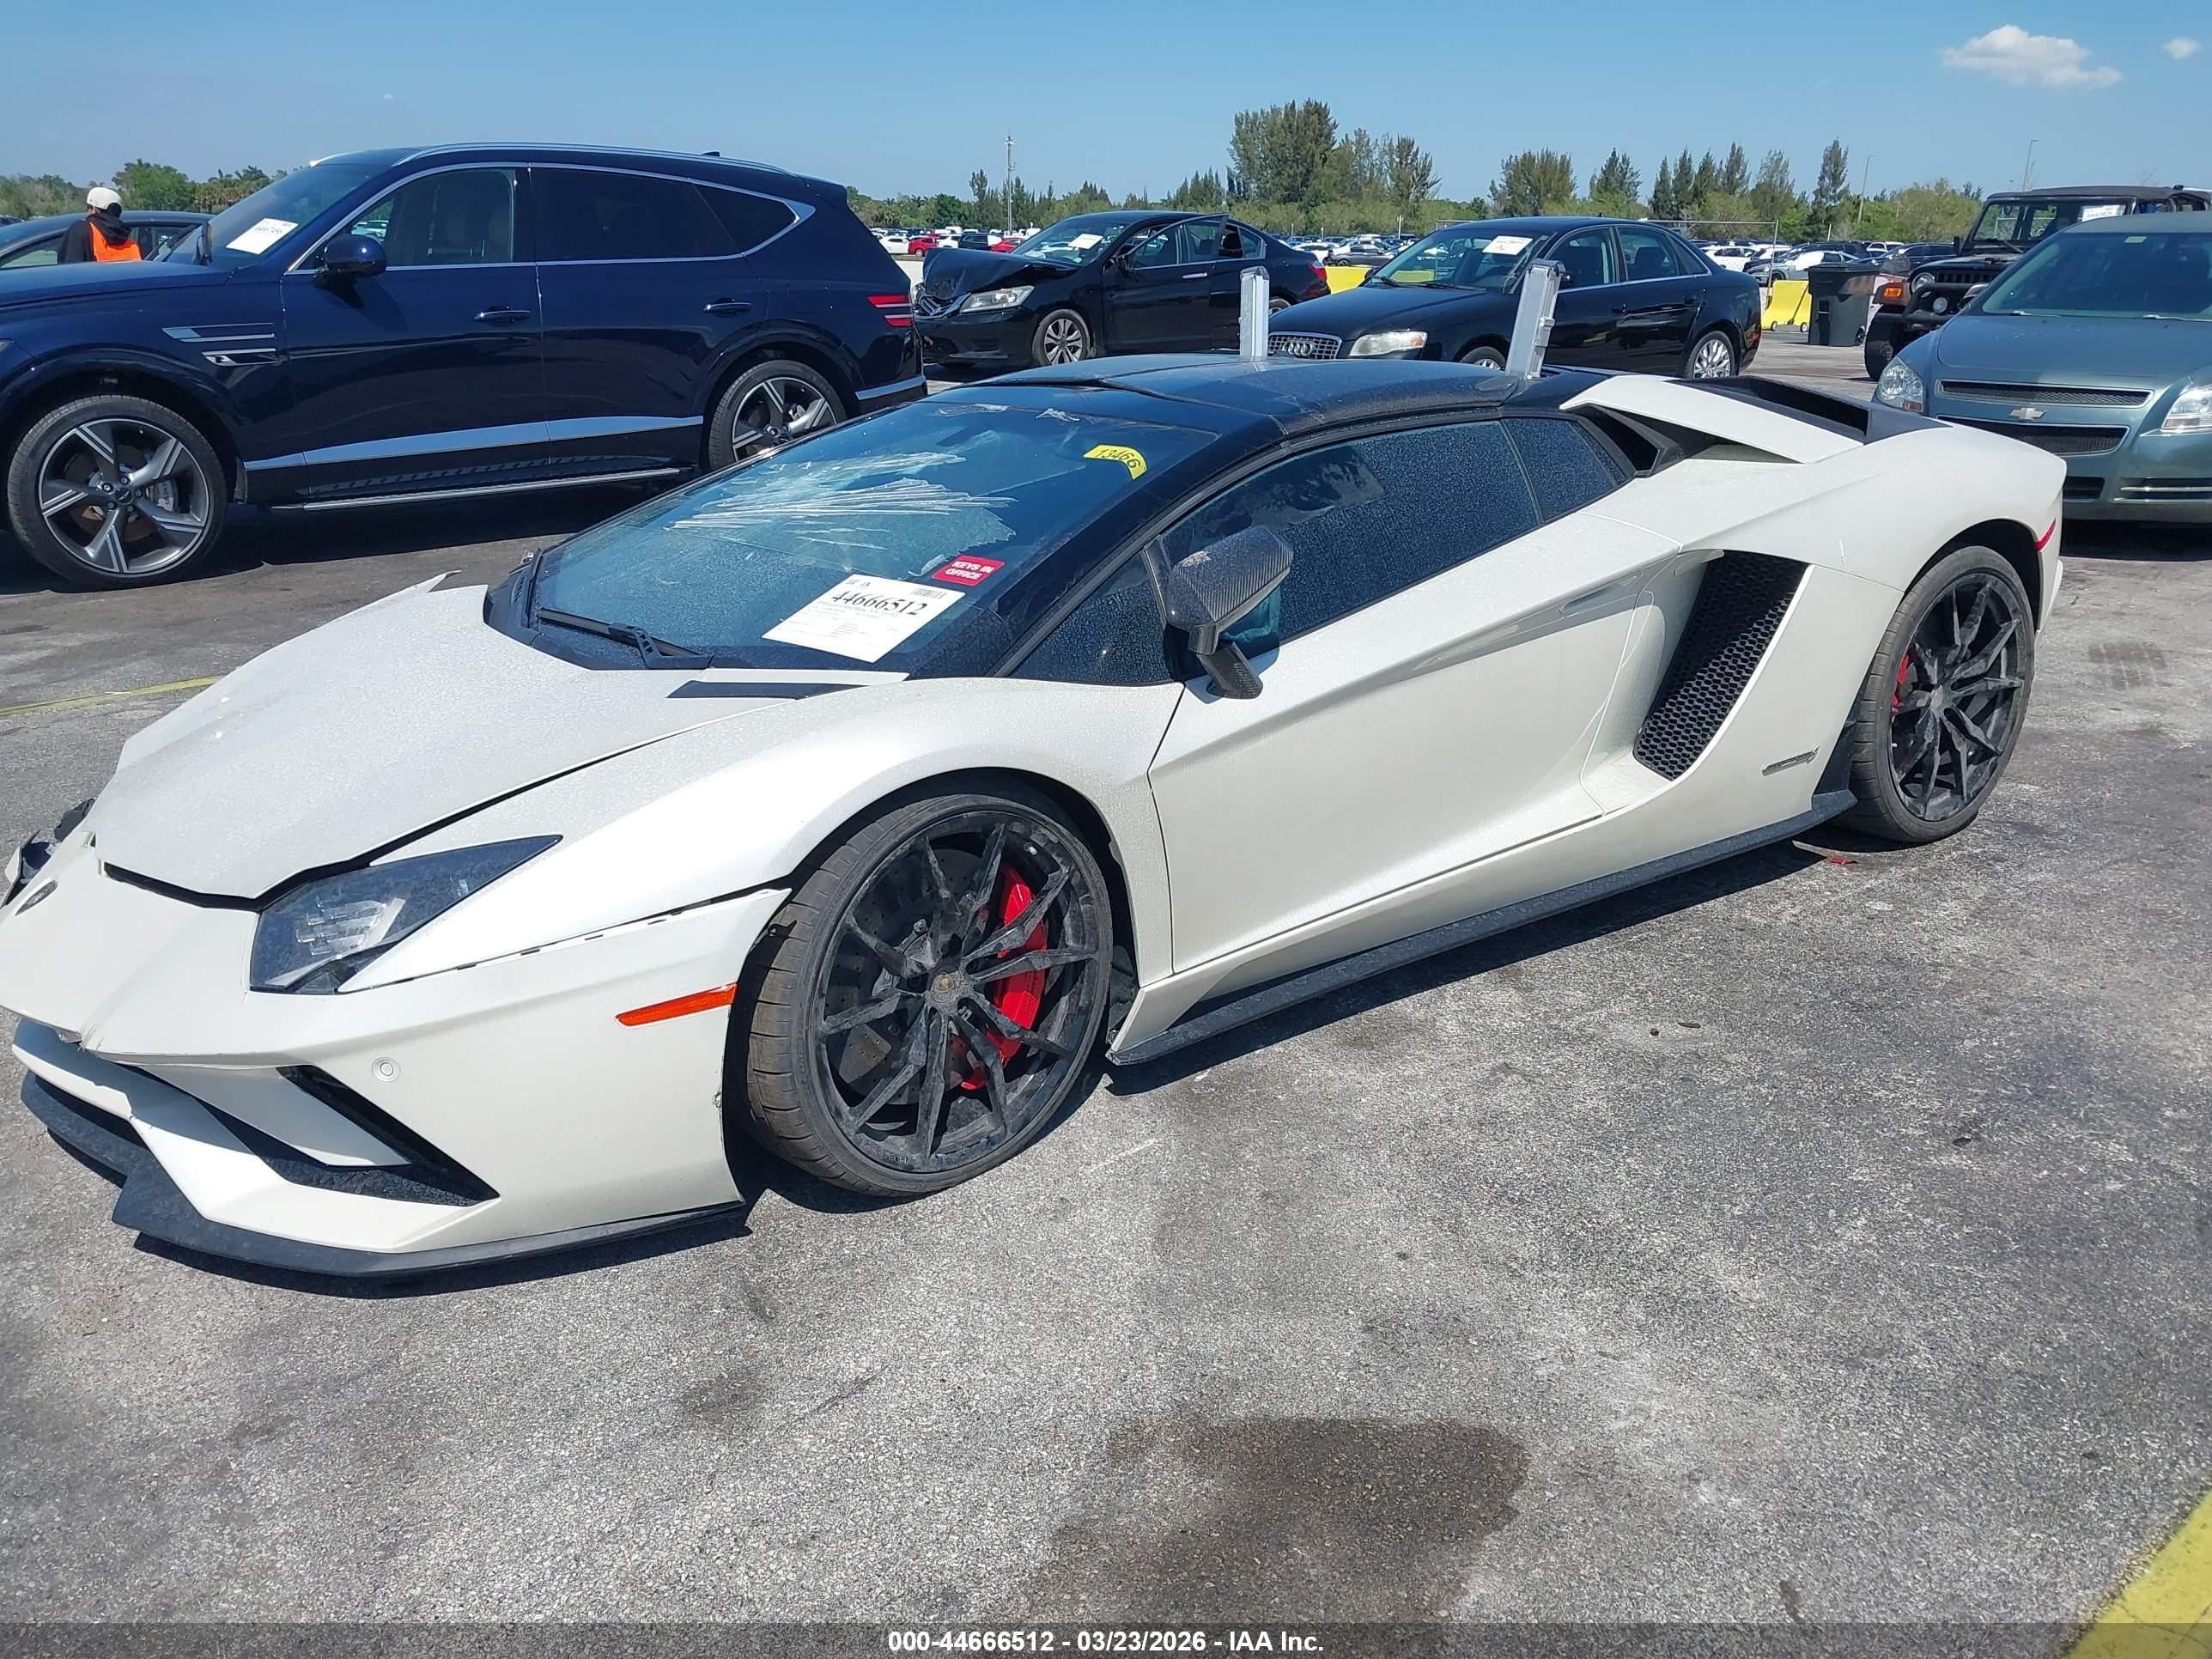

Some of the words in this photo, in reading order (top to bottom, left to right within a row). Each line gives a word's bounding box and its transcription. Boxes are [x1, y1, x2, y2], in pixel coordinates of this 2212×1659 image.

[1095, 448, 1141, 469] 13466
[945, 568, 982, 580] OFFICE
[951, 561, 981, 571] KEYS
[980, 565, 995, 574] IN
[831, 591, 927, 616] 44666512
